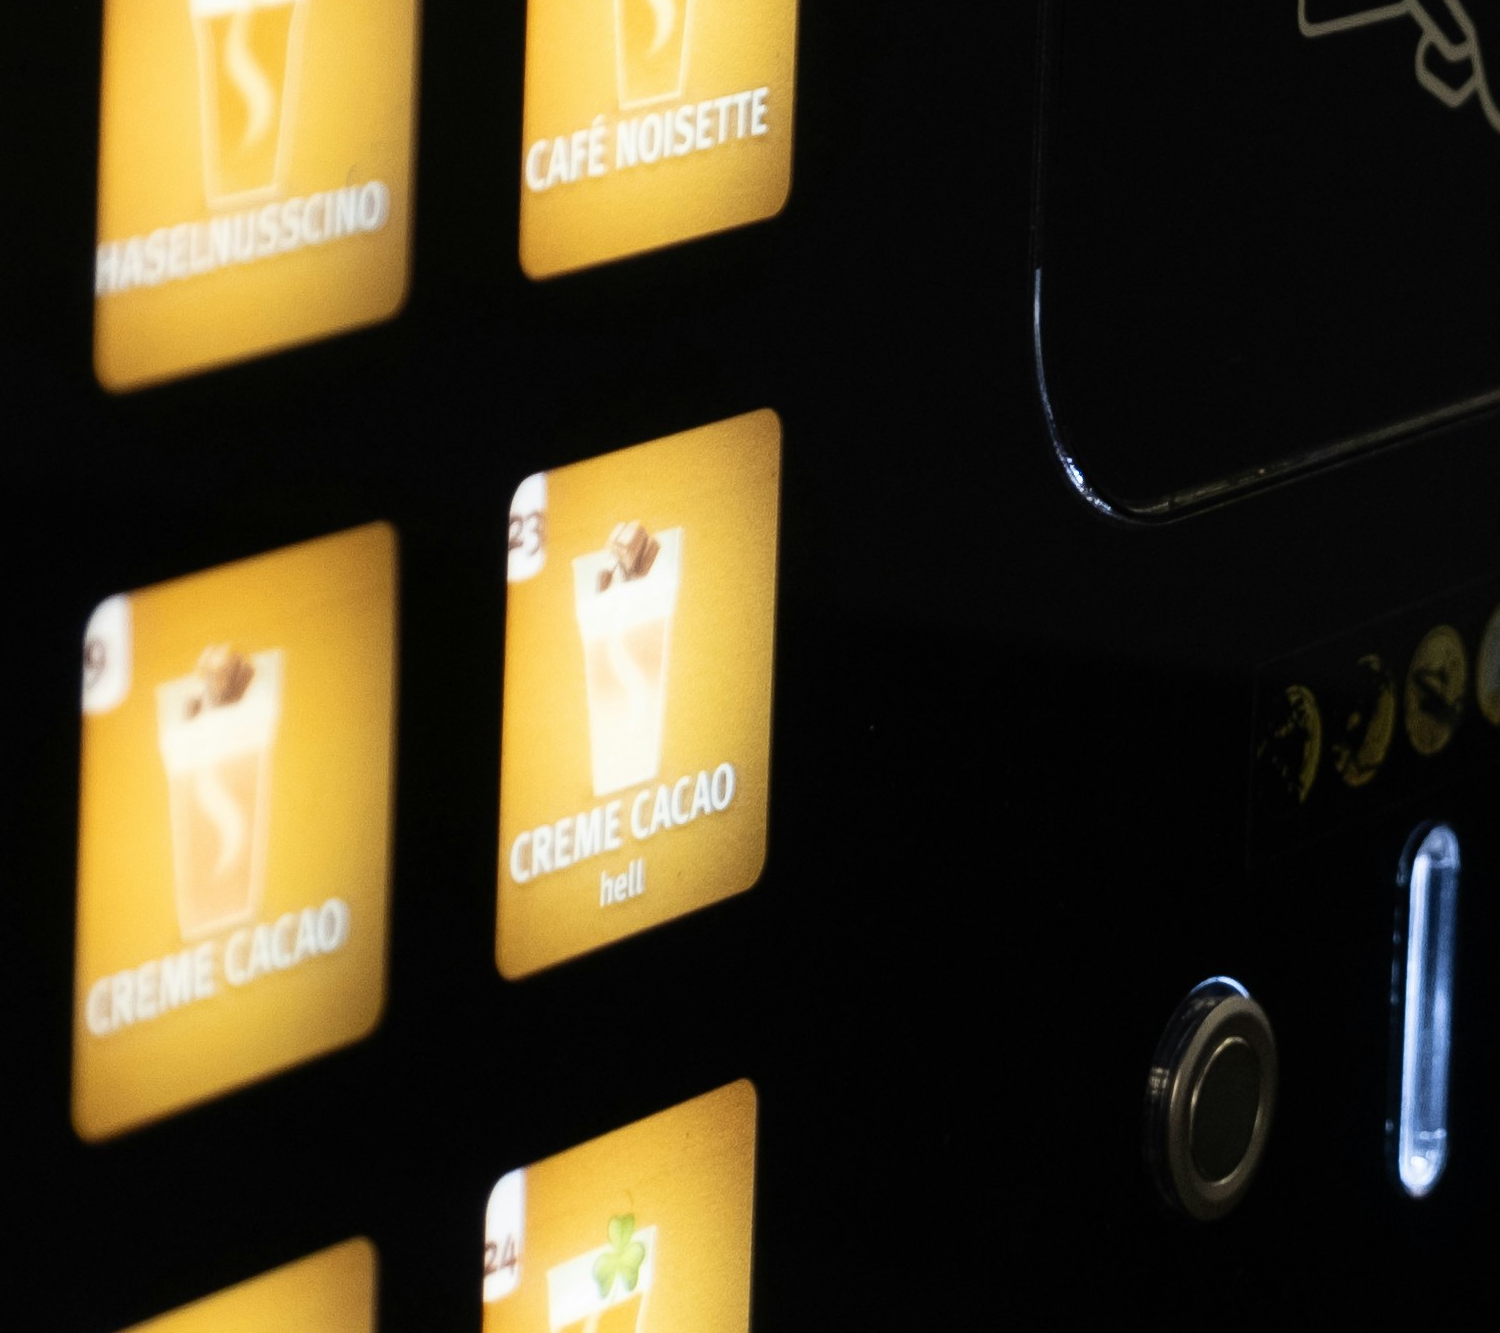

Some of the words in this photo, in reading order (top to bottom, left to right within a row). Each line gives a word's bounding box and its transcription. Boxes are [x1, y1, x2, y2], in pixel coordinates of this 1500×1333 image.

[525, 114, 608, 193] CAFÉ
[615, 87, 770, 170] NOISETTE
[95, 180, 389, 297] HASELNUSSCINO
[510, 799, 623, 885] CREME
[631, 762, 737, 840] CACAO
[600, 859, 645, 909] hell
[85, 942, 216, 1038] CREME
[224, 897, 349, 988] CACAO
[483, 1236, 518, 1277] 24
